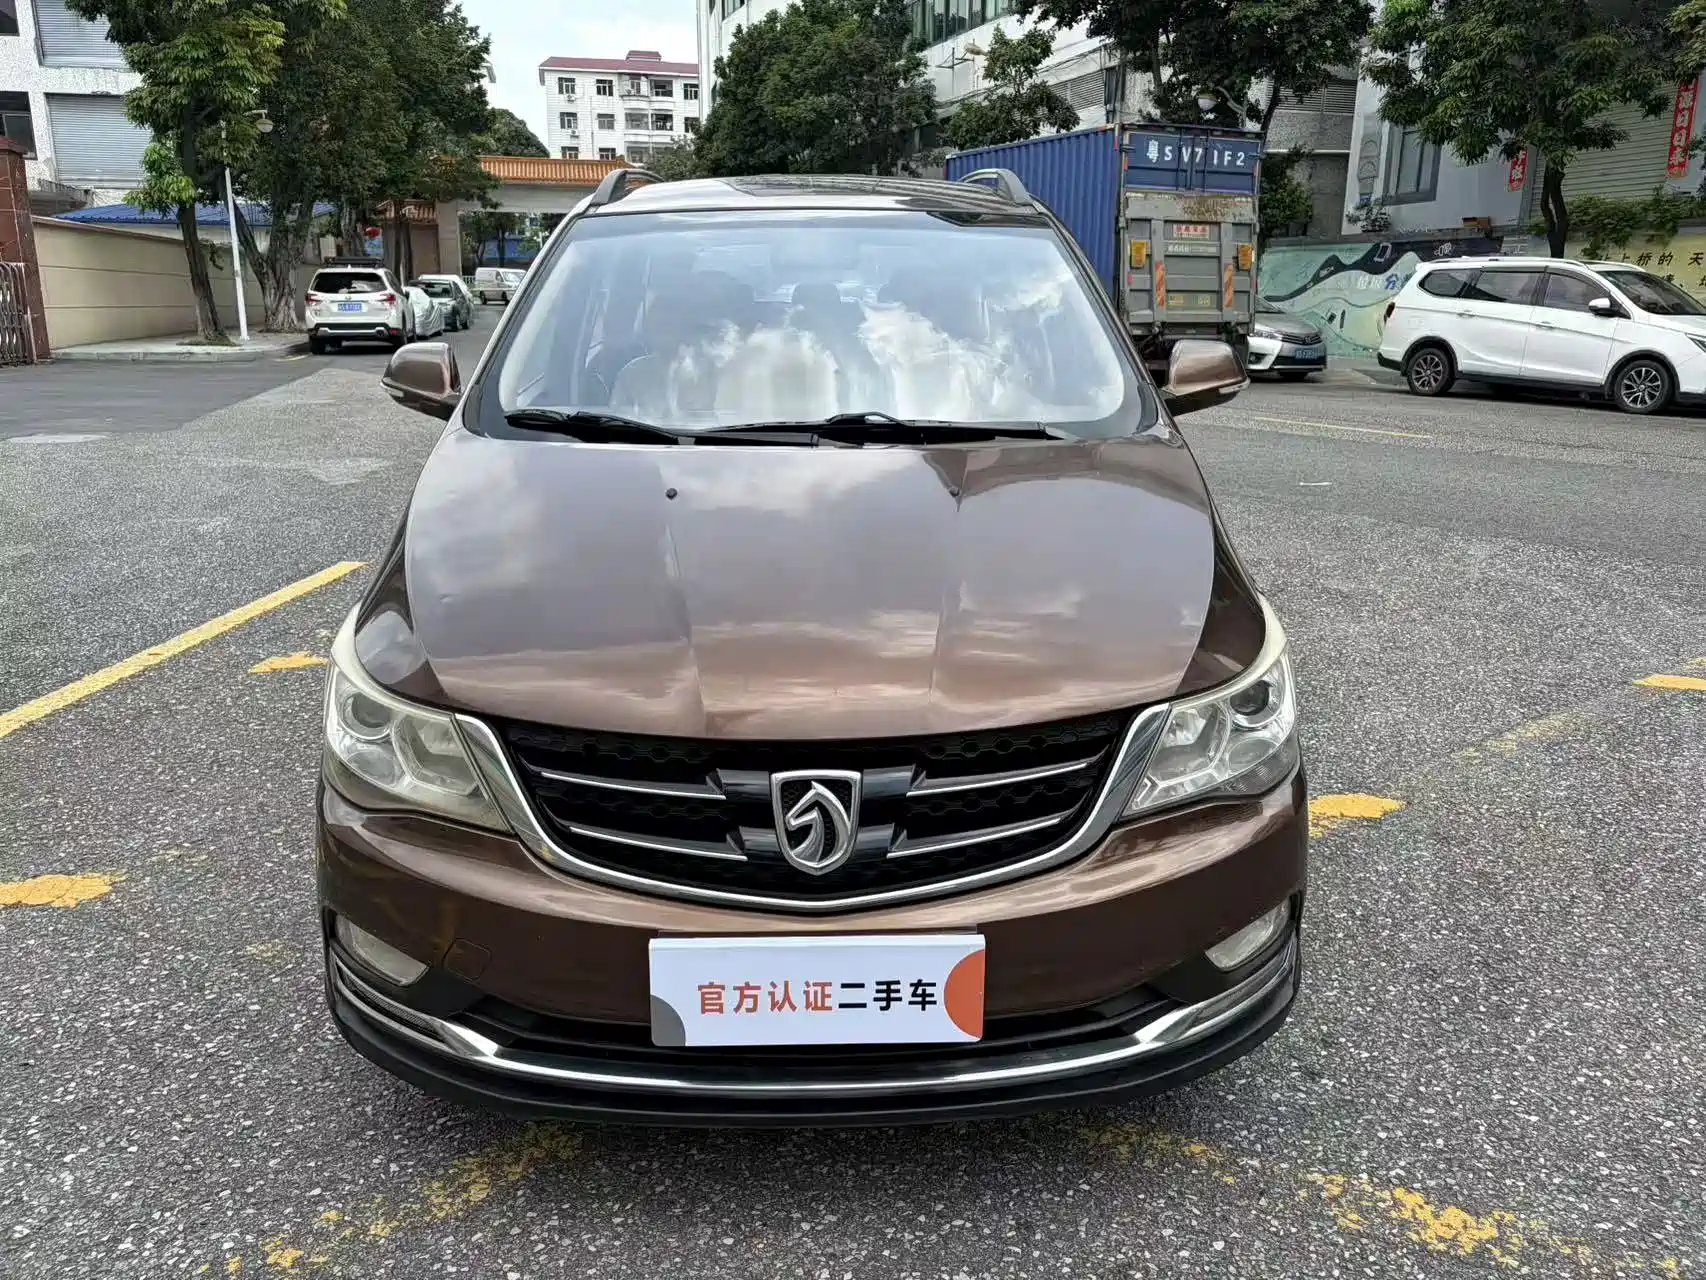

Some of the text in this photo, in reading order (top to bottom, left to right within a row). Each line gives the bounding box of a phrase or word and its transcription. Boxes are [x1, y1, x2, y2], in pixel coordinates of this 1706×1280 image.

[697, 979, 938, 1015] 官方认证二手车
